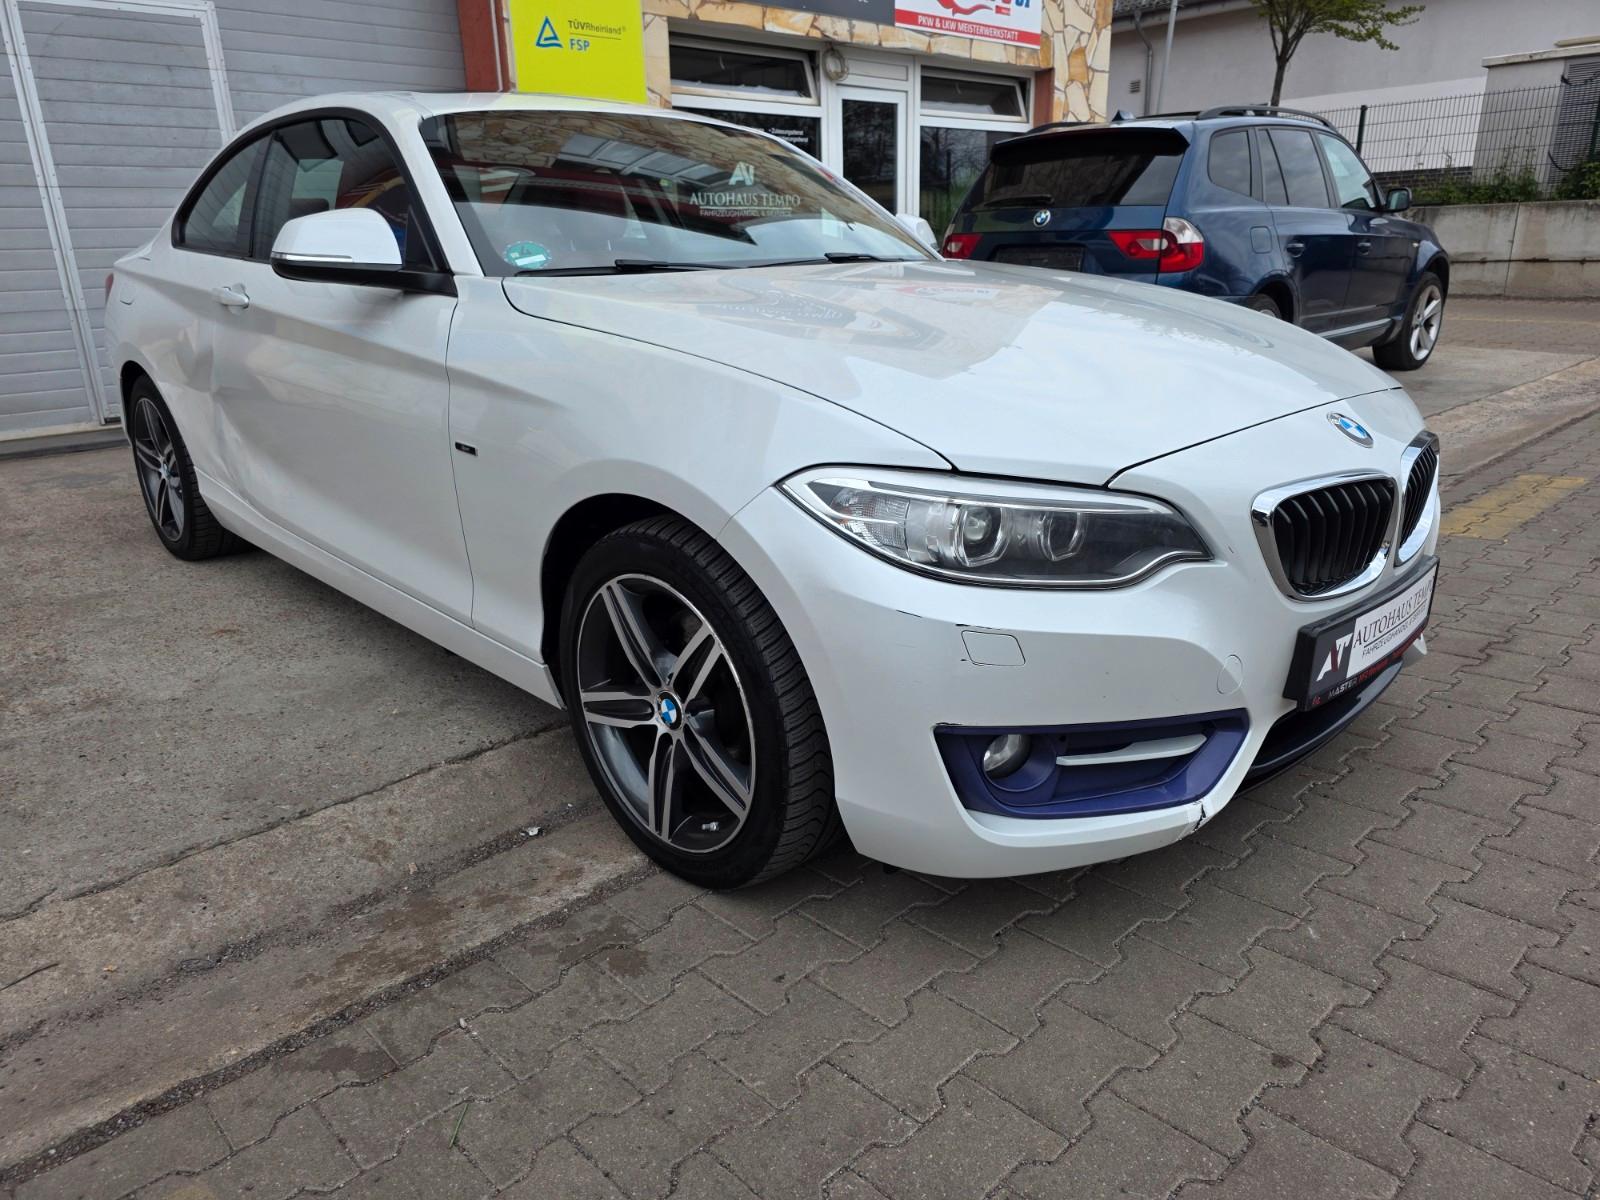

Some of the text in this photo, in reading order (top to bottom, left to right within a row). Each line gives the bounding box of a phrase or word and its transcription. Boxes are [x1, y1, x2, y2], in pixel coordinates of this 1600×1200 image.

[918, 15, 934, 27] PKW
[935, 20, 941, 28] &
[942, 20, 957, 31] LKW
[569, 38, 590, 52] FSP
[689, 191, 801, 207] AUTOHAUS TEMPO
[1353, 596, 1413, 649] AUTOHAUS
